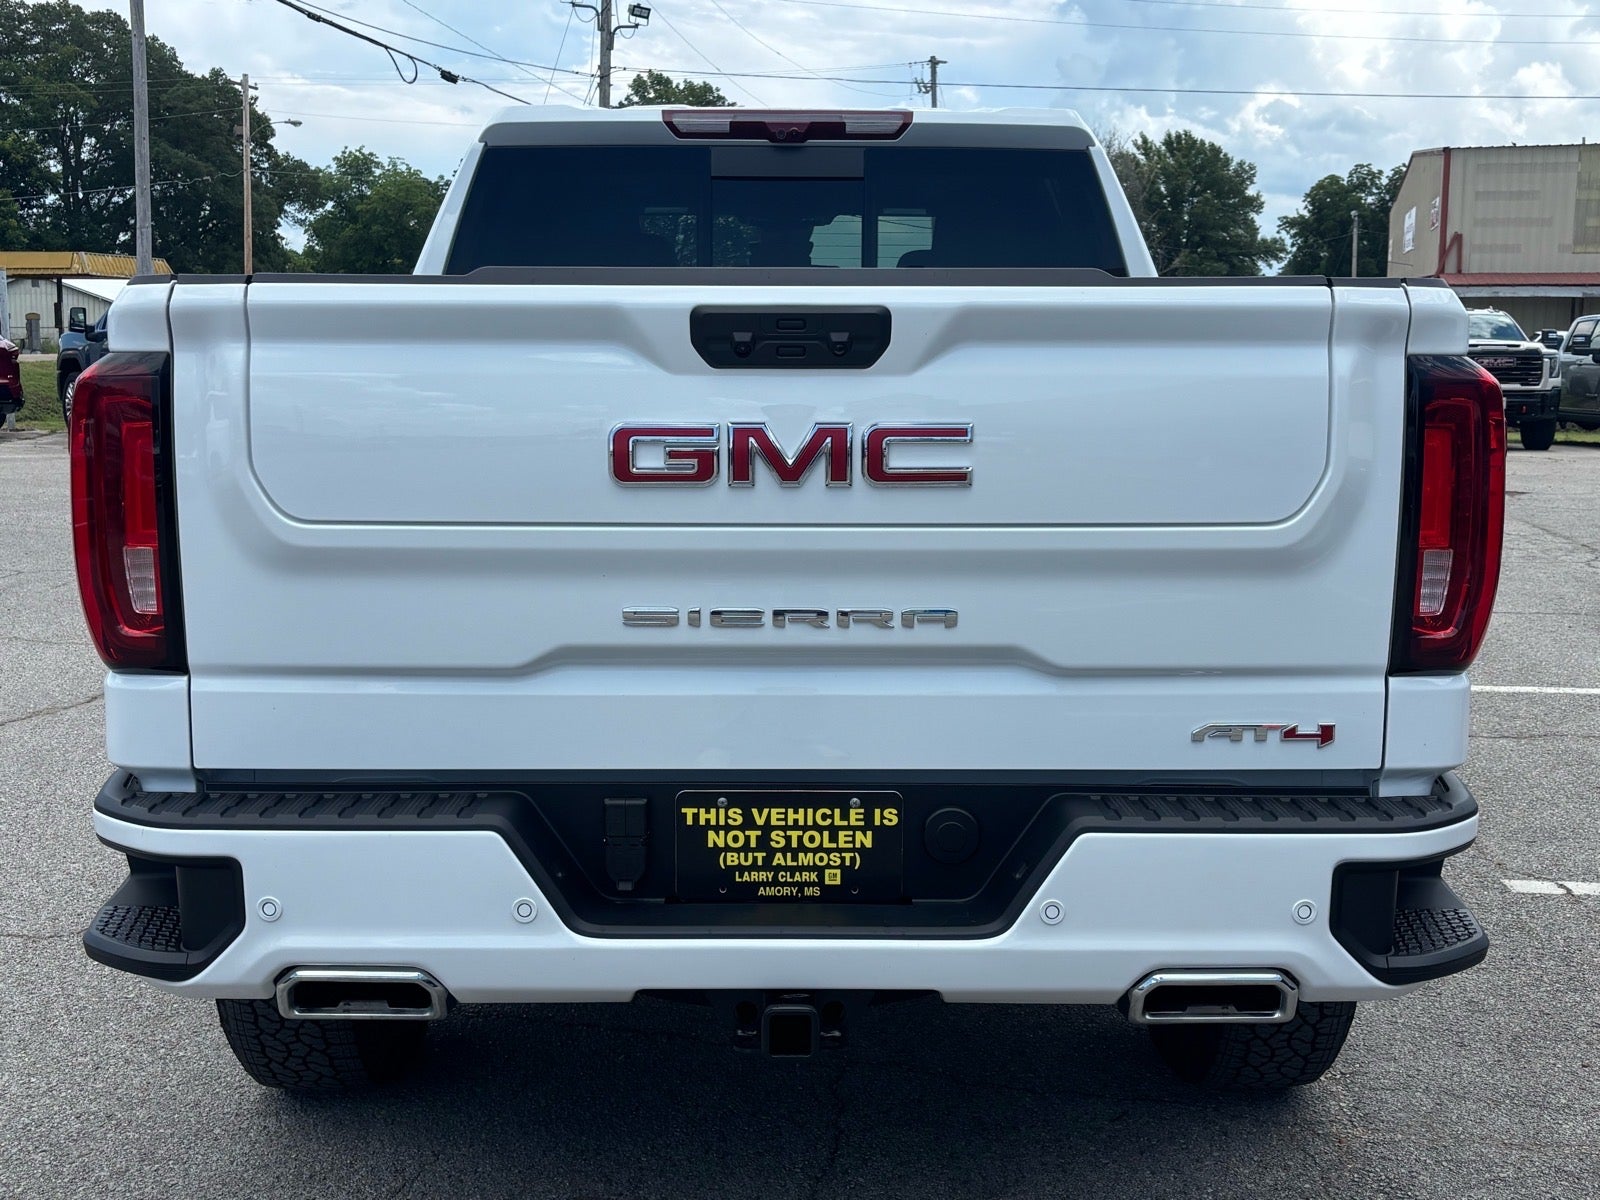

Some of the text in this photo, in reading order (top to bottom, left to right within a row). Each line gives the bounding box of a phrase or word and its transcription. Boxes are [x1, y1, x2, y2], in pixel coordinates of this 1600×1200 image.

[608, 421, 974, 487] GMC
[622, 606, 958, 629] SIERRA
[1191, 722, 1336, 749] AT4
[681, 807, 899, 826] THIS VEHICLE IS
[707, 830, 873, 849] NOT STOLEN
[719, 852, 861, 870] (BUT ALMOST)
[735, 871, 774, 882] LARRY
[778, 871, 819, 882] CLARK
[758, 886, 821, 898] AMORY, MS
